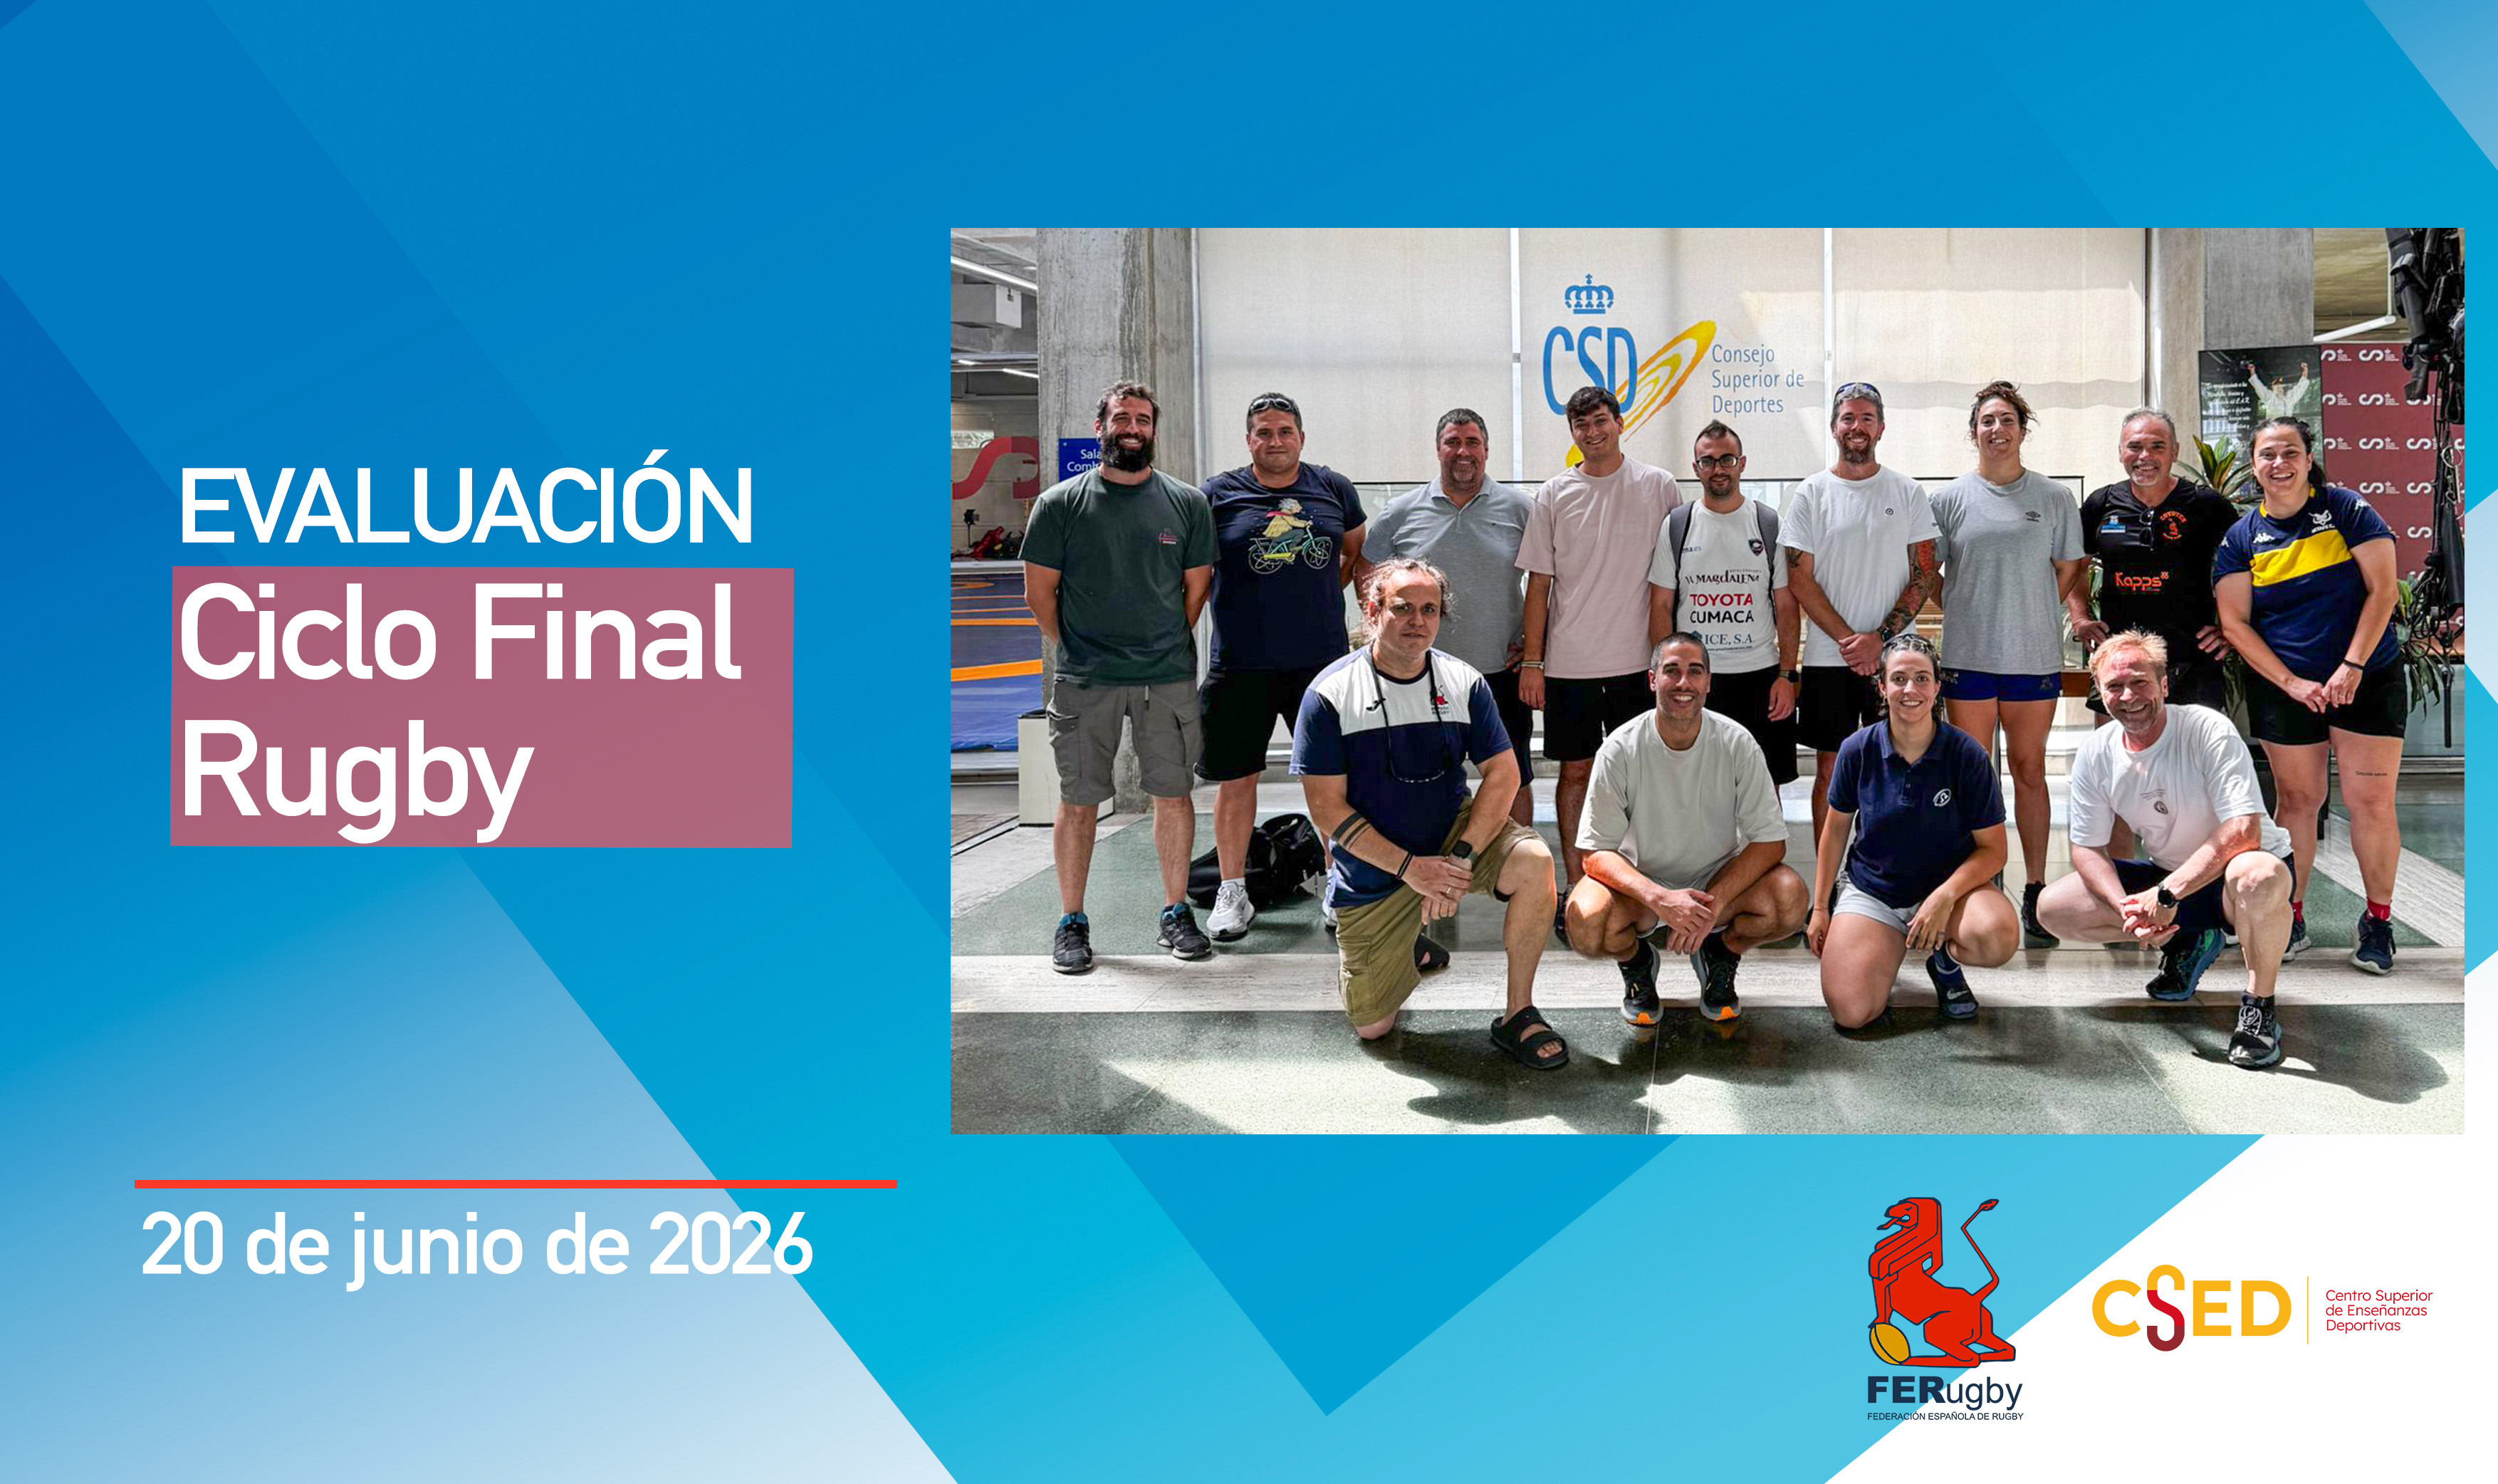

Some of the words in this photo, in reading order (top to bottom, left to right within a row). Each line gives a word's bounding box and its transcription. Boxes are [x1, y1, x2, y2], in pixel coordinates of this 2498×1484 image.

[1712, 344, 1775, 367] Consejo
[1542, 325, 1638, 416] CSD
[1712, 370, 1780, 392] Superior
[1786, 370, 1804, 387] de
[1713, 395, 1784, 417] Deportes
[1080, 449, 1102, 459] Sala
[1690, 593, 1753, 607] TOYOTA
[1690, 610, 1754, 623] CUMACA
